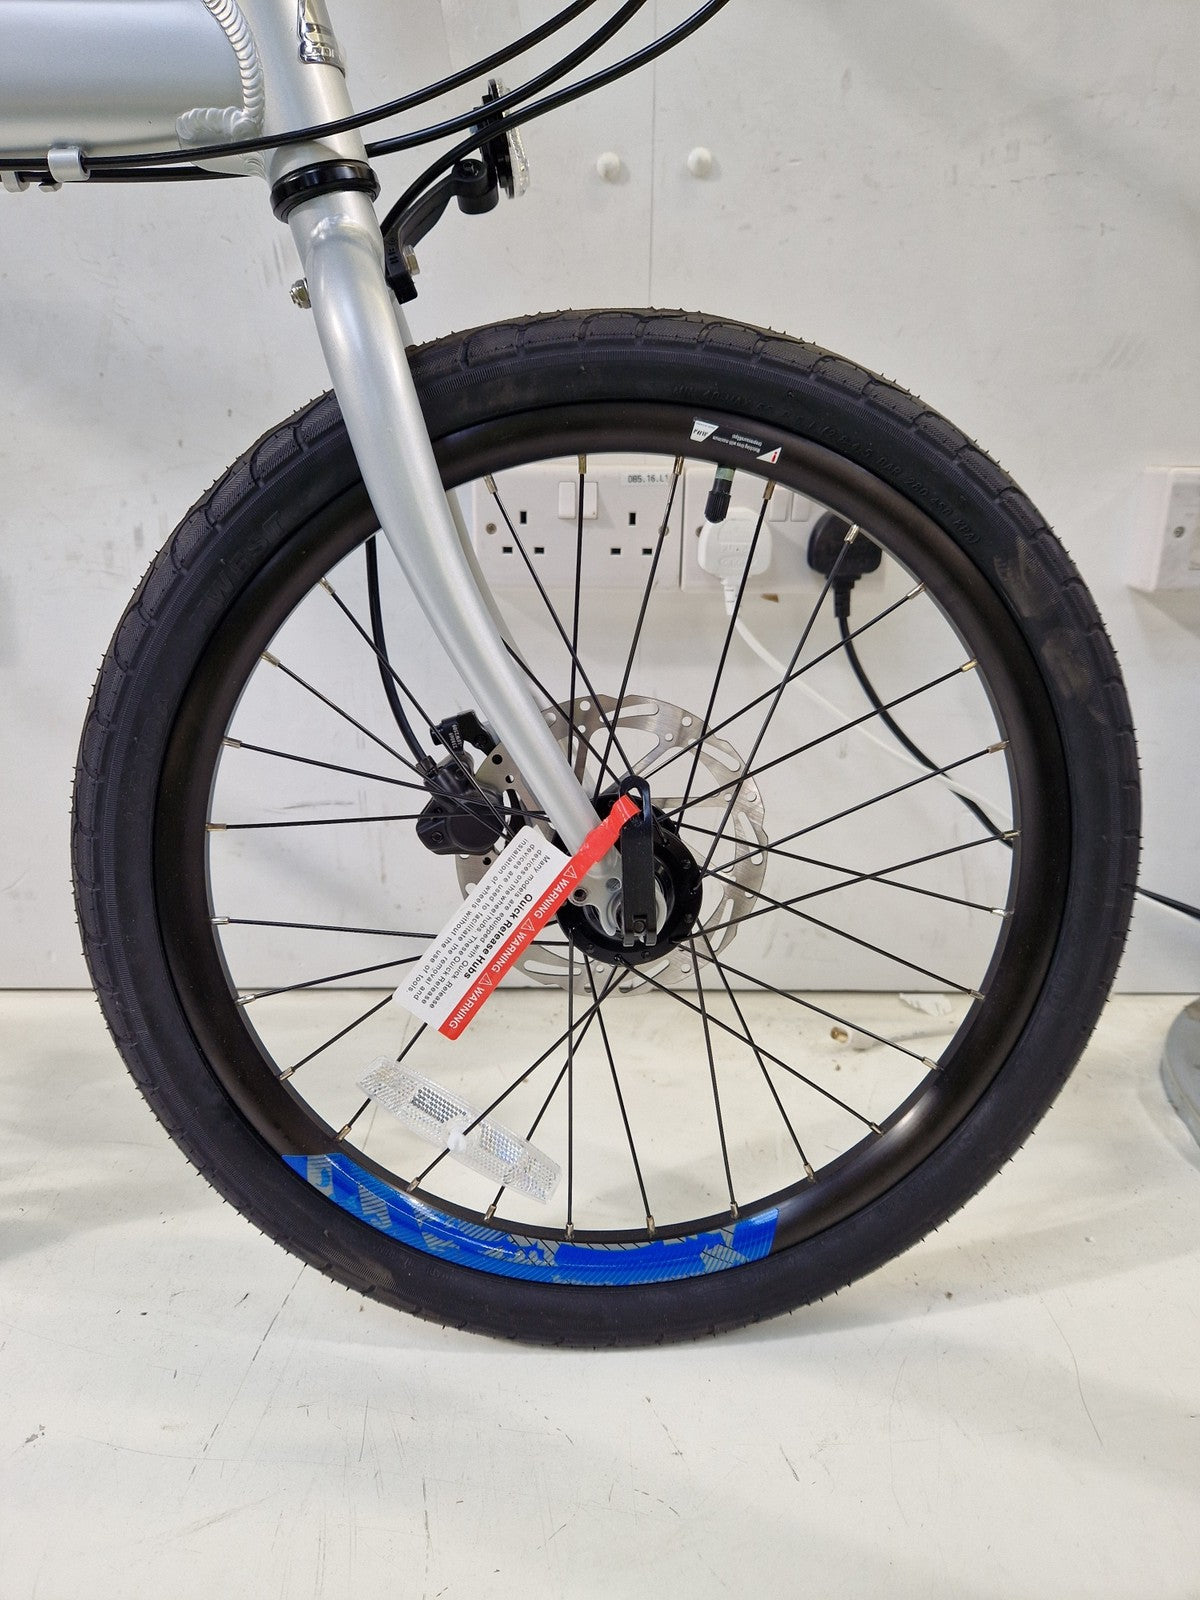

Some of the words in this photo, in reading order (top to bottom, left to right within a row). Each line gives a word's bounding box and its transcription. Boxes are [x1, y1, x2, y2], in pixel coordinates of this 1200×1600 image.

[497, 837, 528, 875] installation
[512, 843, 536, 870] devices
[519, 848, 543, 876] devices
[532, 853, 550, 874] Many
[490, 875, 499, 884] of
[502, 870, 513, 883] are
[513, 874, 522, 884] on
[513, 873, 535, 899] models
[470, 884, 492, 910] wheels
[487, 883, 504, 902] used
[504, 883, 516, 896] the
[533, 876, 569, 920] WARNING
[480, 902, 490, 911] to
[488, 894, 507, 916] wheel
[503, 898, 514, 911] are
[509, 892, 533, 921] Quick
[450, 909, 472, 936] without
[456, 911, 483, 942] facilitate
[474, 914, 492, 935] hubs.
[478, 911, 505, 943] equipped
[440, 935, 452, 949] the
[457, 933, 477, 956] These
[481, 918, 513, 956] Release
[428, 949, 441, 963] use
[446, 942, 459, 956] the
[467, 943, 481, 959] with
[490, 929, 527, 974] WARNING
[421, 963, 430, 973] of
[423, 955, 448, 985] removal
[441, 954, 461, 977] Quick
[450, 959, 469, 980] Quick
[462, 954, 485, 980] Hubs
[405, 973, 423, 995] tools.
[412, 985, 426, 1001] and
[420, 974, 445, 1005] Release
[428, 980, 453, 1010] Release
[447, 985, 485, 1030] WARNING
